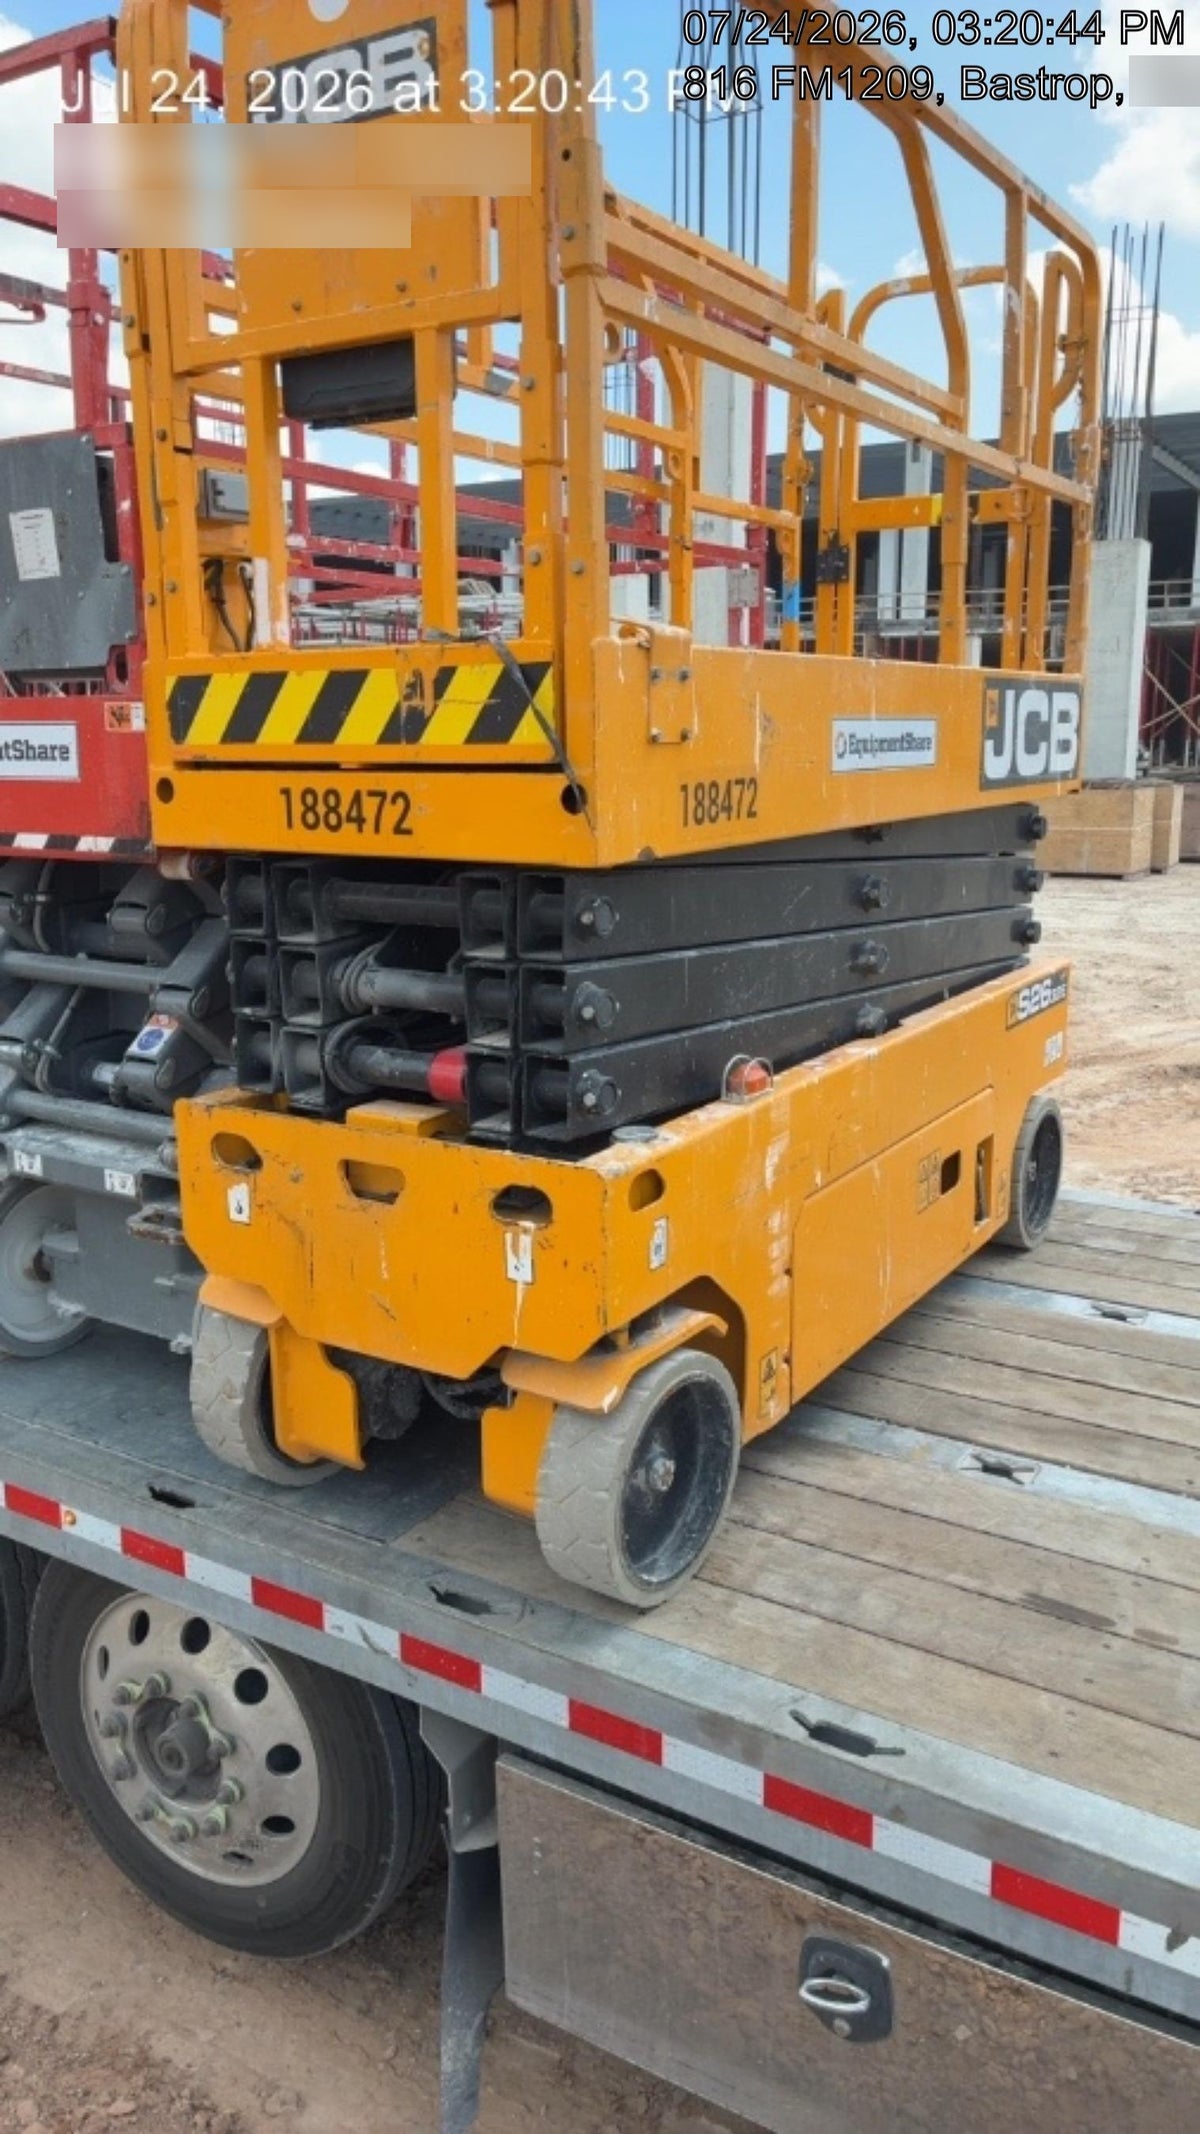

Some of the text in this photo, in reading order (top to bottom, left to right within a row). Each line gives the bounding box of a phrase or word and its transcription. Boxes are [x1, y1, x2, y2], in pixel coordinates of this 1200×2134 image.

[0, 739, 70, 761] tShare
[984, 689, 1080, 779] JCB
[279, 786, 413, 835] 188472
[680, 776, 758, 828] 188472
